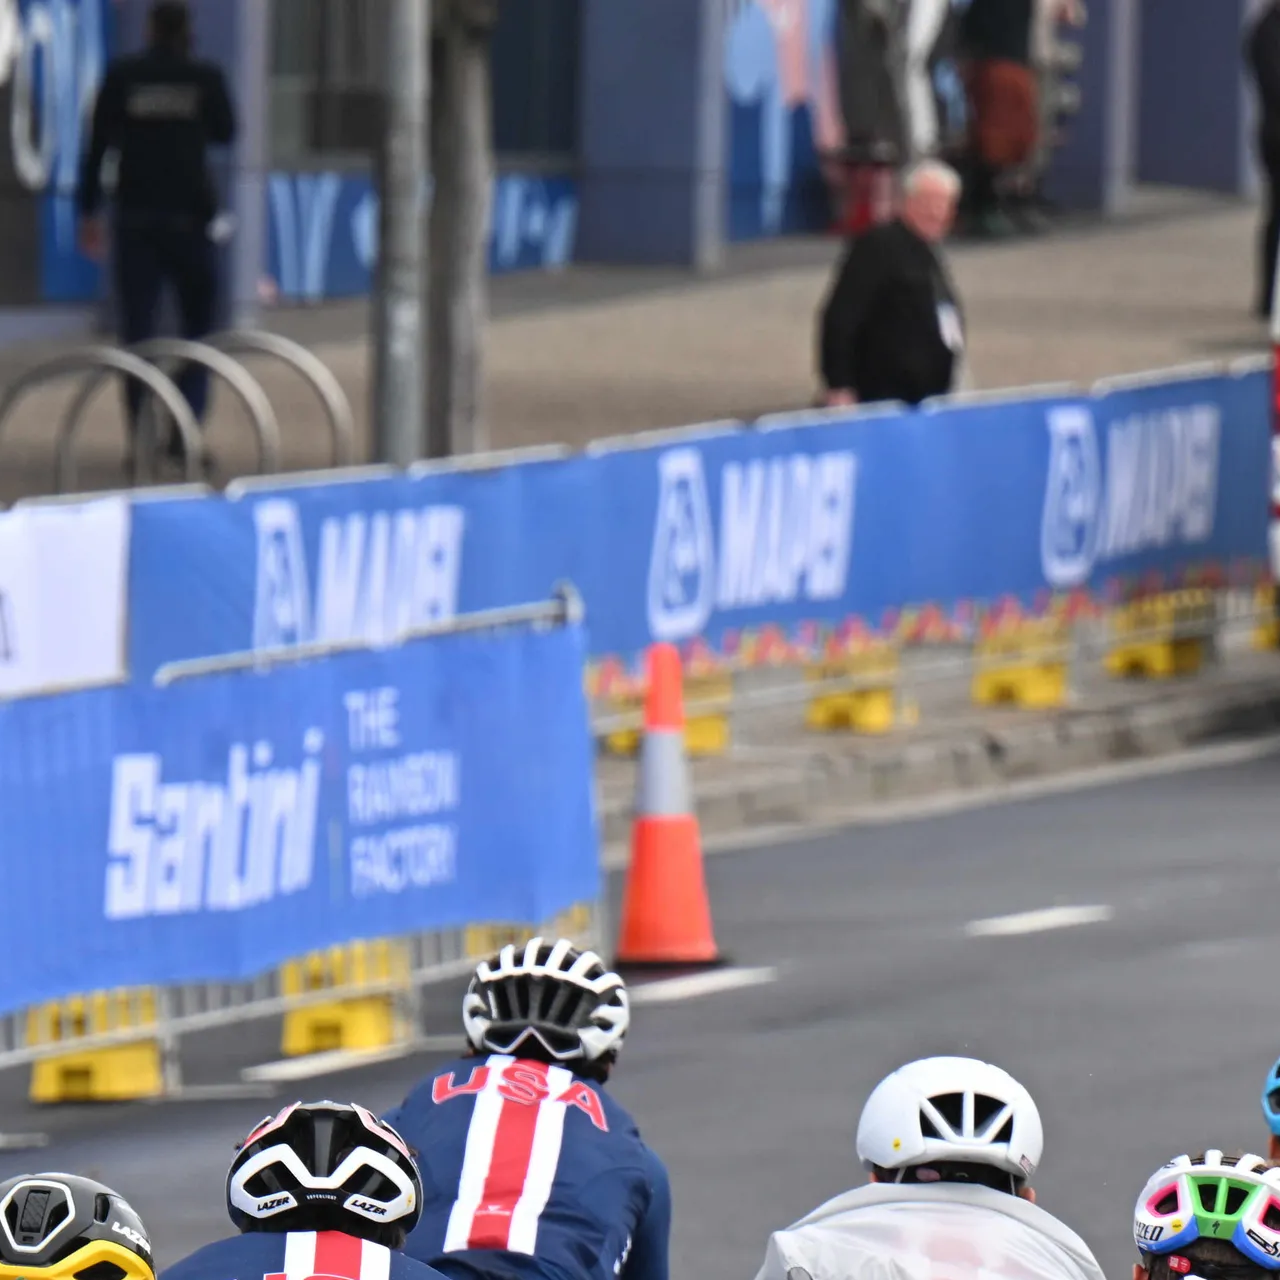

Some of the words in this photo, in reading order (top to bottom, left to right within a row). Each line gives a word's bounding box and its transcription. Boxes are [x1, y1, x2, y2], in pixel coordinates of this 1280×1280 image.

[342, 687, 402, 748] THE
[105, 723, 324, 921] Santini
[432, 1062, 610, 1132] USA
[257, 1196, 290, 1212] LAZER
[351, 1199, 388, 1216] LAZER
[1135, 1220, 1164, 1242] IZED
